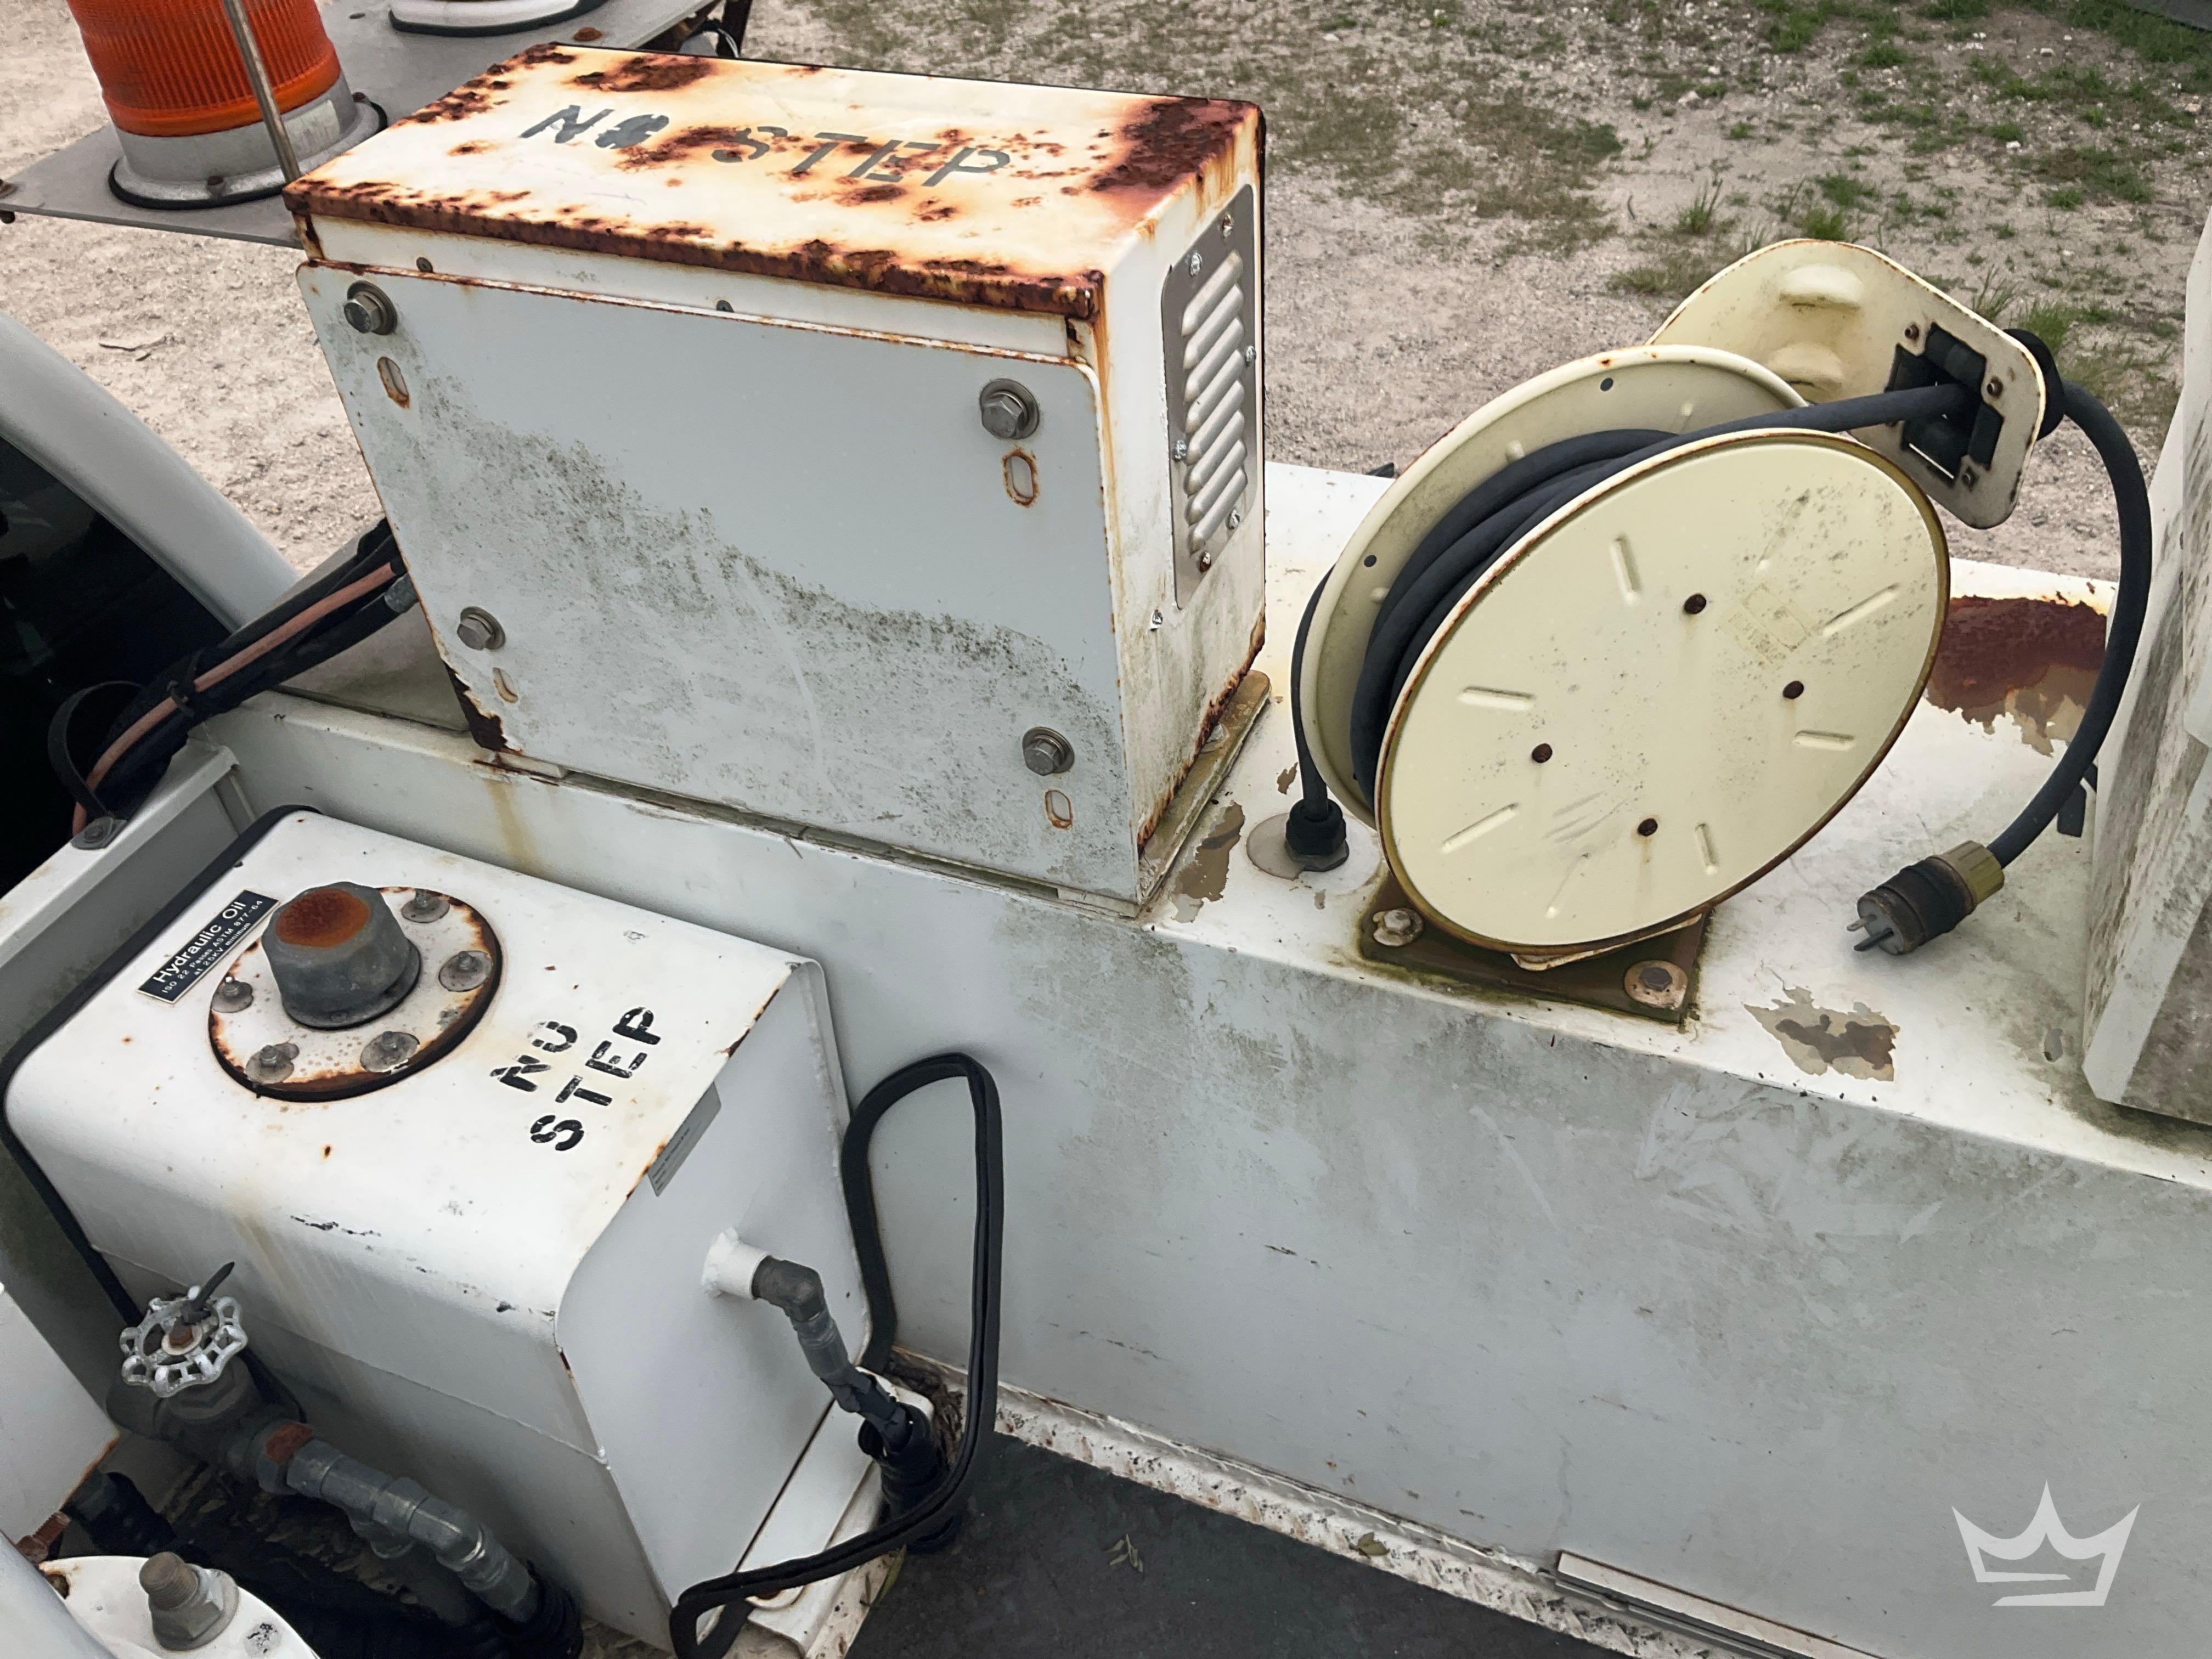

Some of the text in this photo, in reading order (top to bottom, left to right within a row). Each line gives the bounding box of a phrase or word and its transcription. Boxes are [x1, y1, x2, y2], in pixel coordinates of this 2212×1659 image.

[519, 104, 1010, 187] NO STEP
[153, 901, 246, 983] Hydraulic Oil
[178, 969, 189, 979] 22
[212, 928, 234, 947] ASTM
[225, 923, 251, 946] minimum
[489, 1020, 578, 1092] NO
[529, 1006, 662, 1152] STEP
